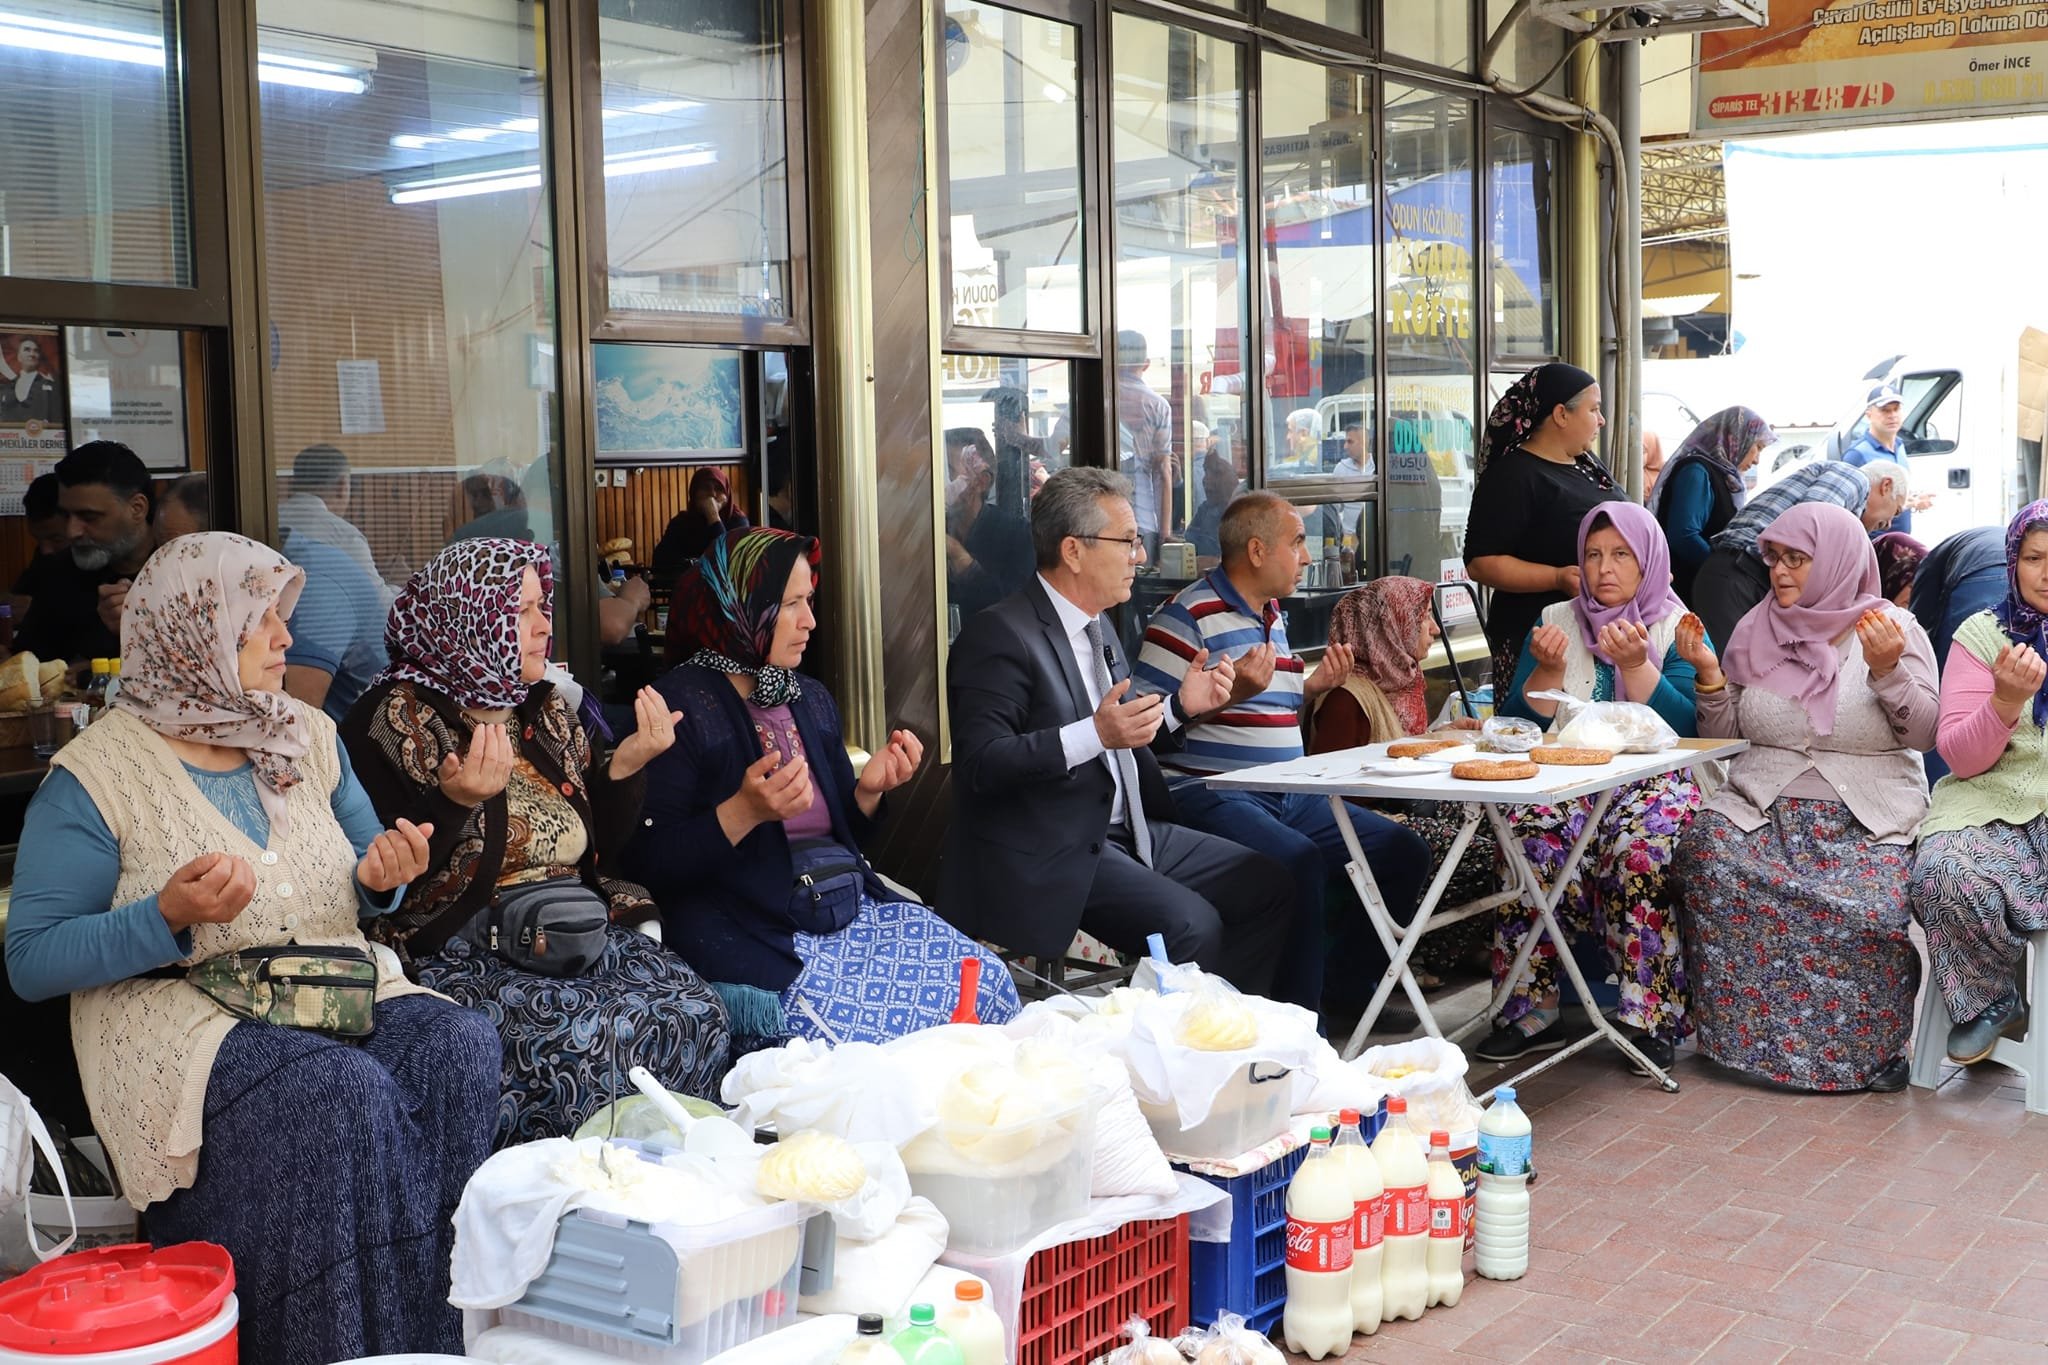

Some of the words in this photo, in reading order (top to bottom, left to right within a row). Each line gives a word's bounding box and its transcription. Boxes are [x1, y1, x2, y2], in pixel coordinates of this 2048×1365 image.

[1812, 8, 1859, 28] Çuval
[1858, 22, 1956, 46] Açılışlarda
[1960, 15, 2020, 35] Lokma
[2024, 10, 2048, 29] Dö
[1968, 58, 2000, 72] Ömer
[2003, 55, 2031, 69] İNCE
[1711, 100, 1744, 115] SİPARİŞ
[1745, 99, 1759, 111] TEL
[1760, 91, 1804, 117] 313
[1813, 86, 1845, 113] 48
[1392, 202, 1419, 232] ODUN
